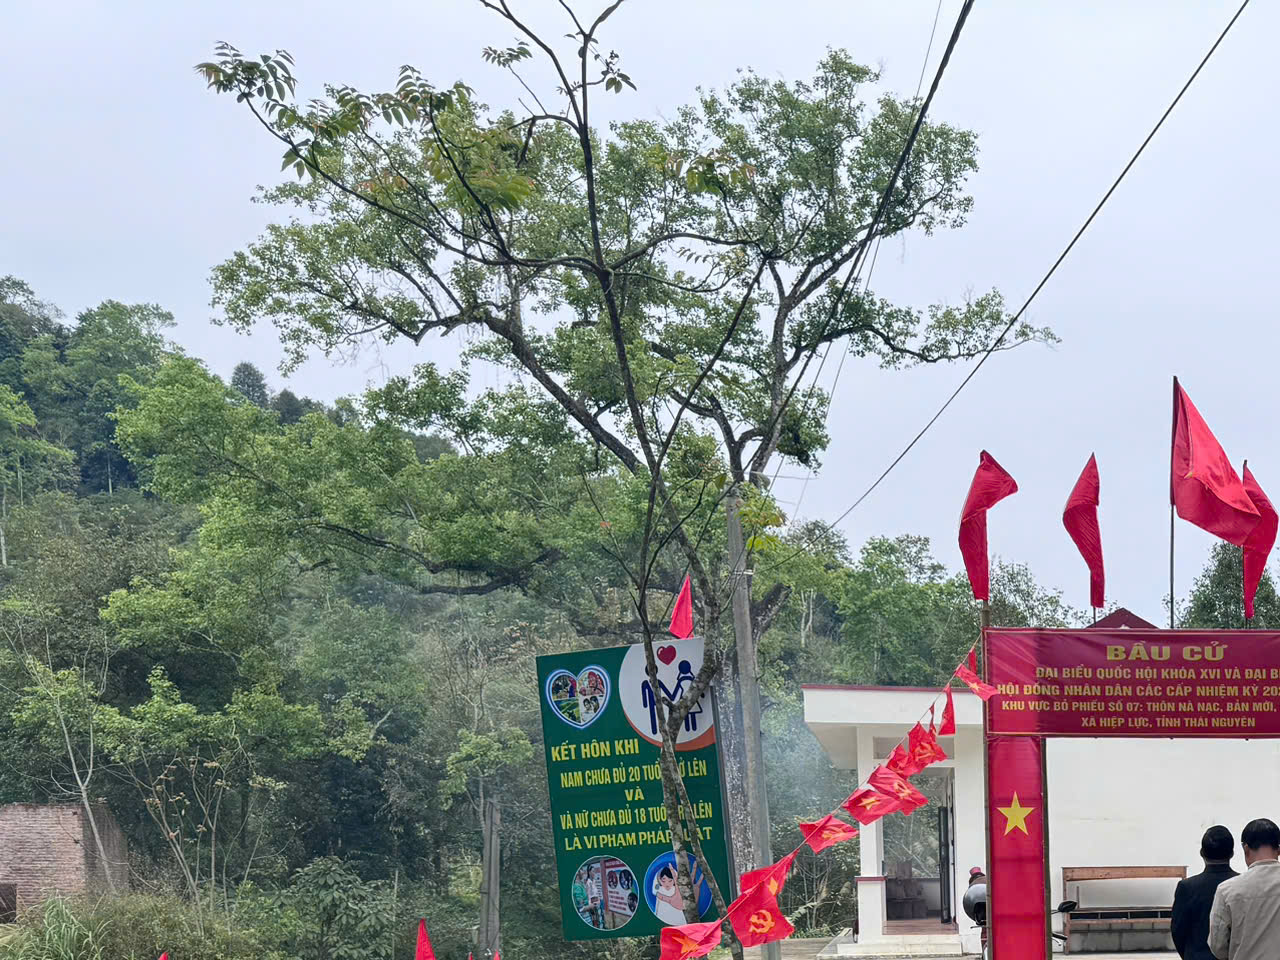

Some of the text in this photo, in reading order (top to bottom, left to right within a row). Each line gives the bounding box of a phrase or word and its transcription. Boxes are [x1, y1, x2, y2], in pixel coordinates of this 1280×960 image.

[1106, 641, 1228, 661] BẦU CỬ
[1036, 667, 1058, 680] ĐẠI
[1063, 664, 1092, 678] BIỂU
[1096, 665, 1131, 679] QUỐC
[1136, 666, 1157, 681] HỘI
[1161, 666, 1196, 679] KHÓA
[1200, 669, 1221, 679] XVI
[1225, 666, 1241, 679] VÀ
[1245, 668, 1266, 681] ĐẠI
[997, 682, 1020, 697] HỘI
[1023, 682, 1060, 695] ĐỒNG
[1064, 682, 1101, 696] NHÂN
[1105, 683, 1132, 696] DÂN
[1136, 683, 1162, 696] CÁC
[1166, 682, 1192, 696] CẤP
[1196, 684, 1239, 698] NHIỆM
[1243, 683, 1258, 696] KỲ
[1002, 700, 1025, 710] KHU
[1028, 700, 1050, 712] VỰC
[1053, 699, 1068, 711] BỎ
[1072, 699, 1105, 711] PHIẾU
[1108, 699, 1123, 711] SỐ
[1126, 702, 1144, 711] 07:
[1146, 700, 1175, 711] THÔN
[1253, 700, 1277, 712] MỚI,
[1081, 715, 1256, 729] XÃ HIỆP LỰC, TỈNH THÁI NGUYÊN
[551, 738, 640, 761] KẾT HÔN KHI
[560, 771, 583, 788] NAM
[585, 767, 611, 786] CHƯA
[613, 762, 626, 783] ĐỦ
[628, 766, 640, 782] 20
[642, 757, 662, 781] TUỔ
[687, 757, 707, 777] LÊN
[625, 786, 645, 801] VÀ
[560, 811, 573, 830] VÀ
[575, 809, 589, 829] NỮ
[591, 809, 617, 827] CHƯA
[618, 804, 632, 825] ĐỦ
[634, 807, 646, 823] 18
[648, 800, 667, 823] TUỔ
[693, 800, 713, 819] LÊN
[565, 833, 582, 851] LÀ
[583, 835, 597, 849] VI
[599, 832, 637, 849] PHẠM
[638, 826, 674, 846] PHÁP
